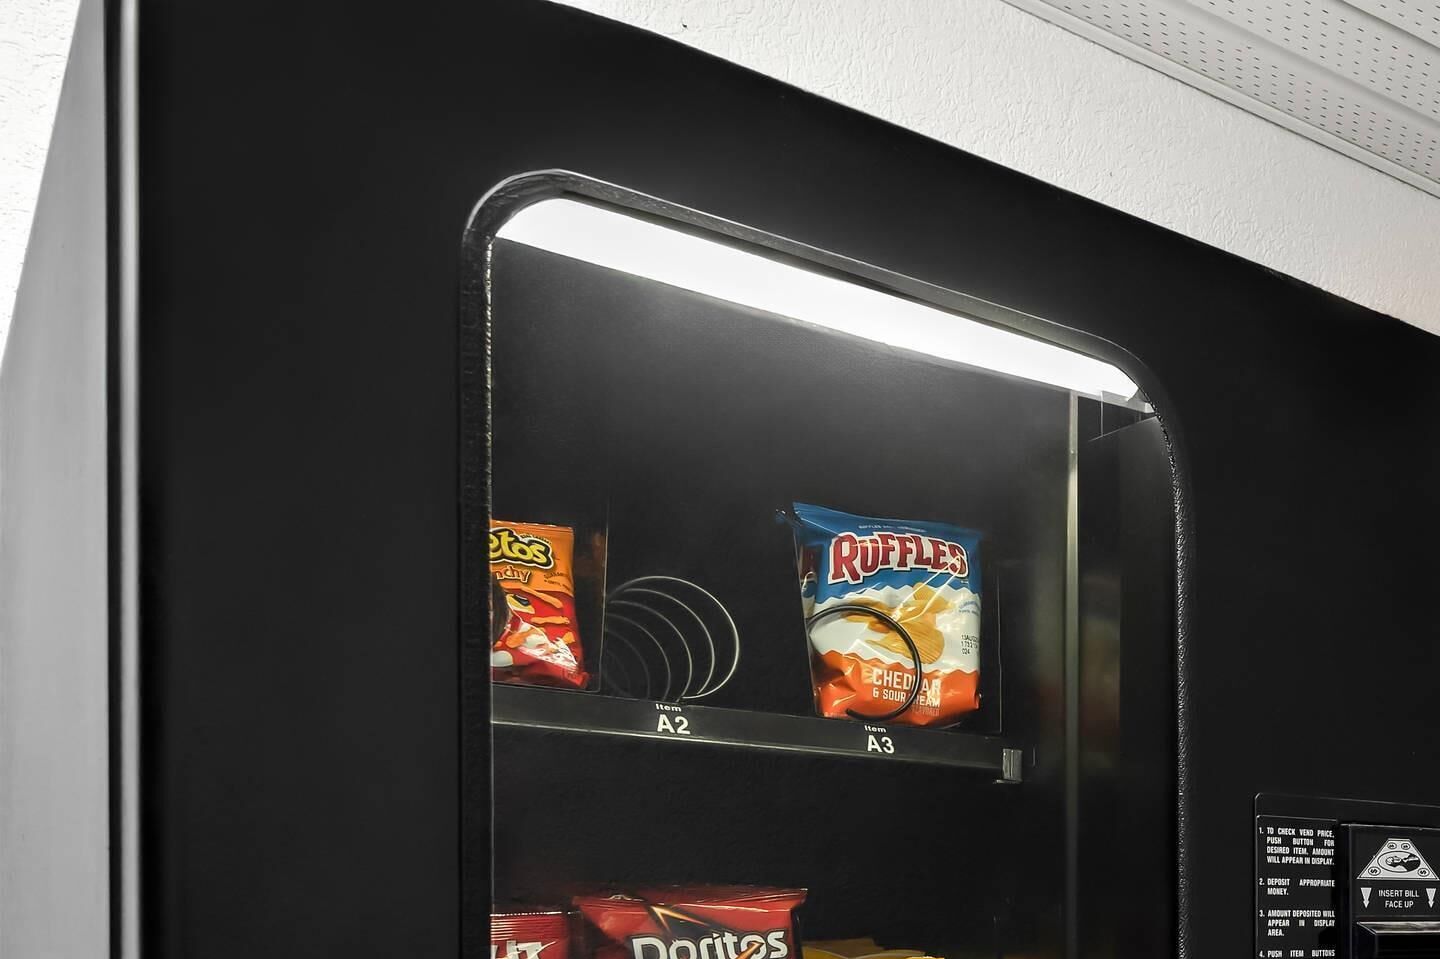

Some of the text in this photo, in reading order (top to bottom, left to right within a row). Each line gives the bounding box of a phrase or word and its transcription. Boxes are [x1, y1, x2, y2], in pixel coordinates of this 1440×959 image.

[829, 532, 969, 584] RUFFLES
[873, 668, 941, 694] CHEDAR
[883, 689, 907, 702] SOUR
[656, 704, 682, 713] Item
[657, 715, 691, 735] A2
[864, 725, 886, 733] Item
[867, 735, 895, 754] A3
[1300, 828, 1313, 837] VEND
[1267, 837, 1335, 847] PUSH BUTTON FOR
[1267, 846, 1289, 854] DESIRED
[1312, 848, 1334, 856] AMOUNT
[1282, 856, 1303, 864] APPEAR
[1311, 857, 1335, 865] DISPLAY.
[1268, 878, 1290, 886] DEPOSIT
[1300, 879, 1335, 887] APPROPRIATE
[1268, 910, 1291, 918] AMOUNT
[1293, 910, 1321, 918] DEPOSITED
[1323, 910, 1335, 918] WILL
[1268, 919, 1289, 927] APPEAR
[1314, 919, 1335, 927] DISPLAY
